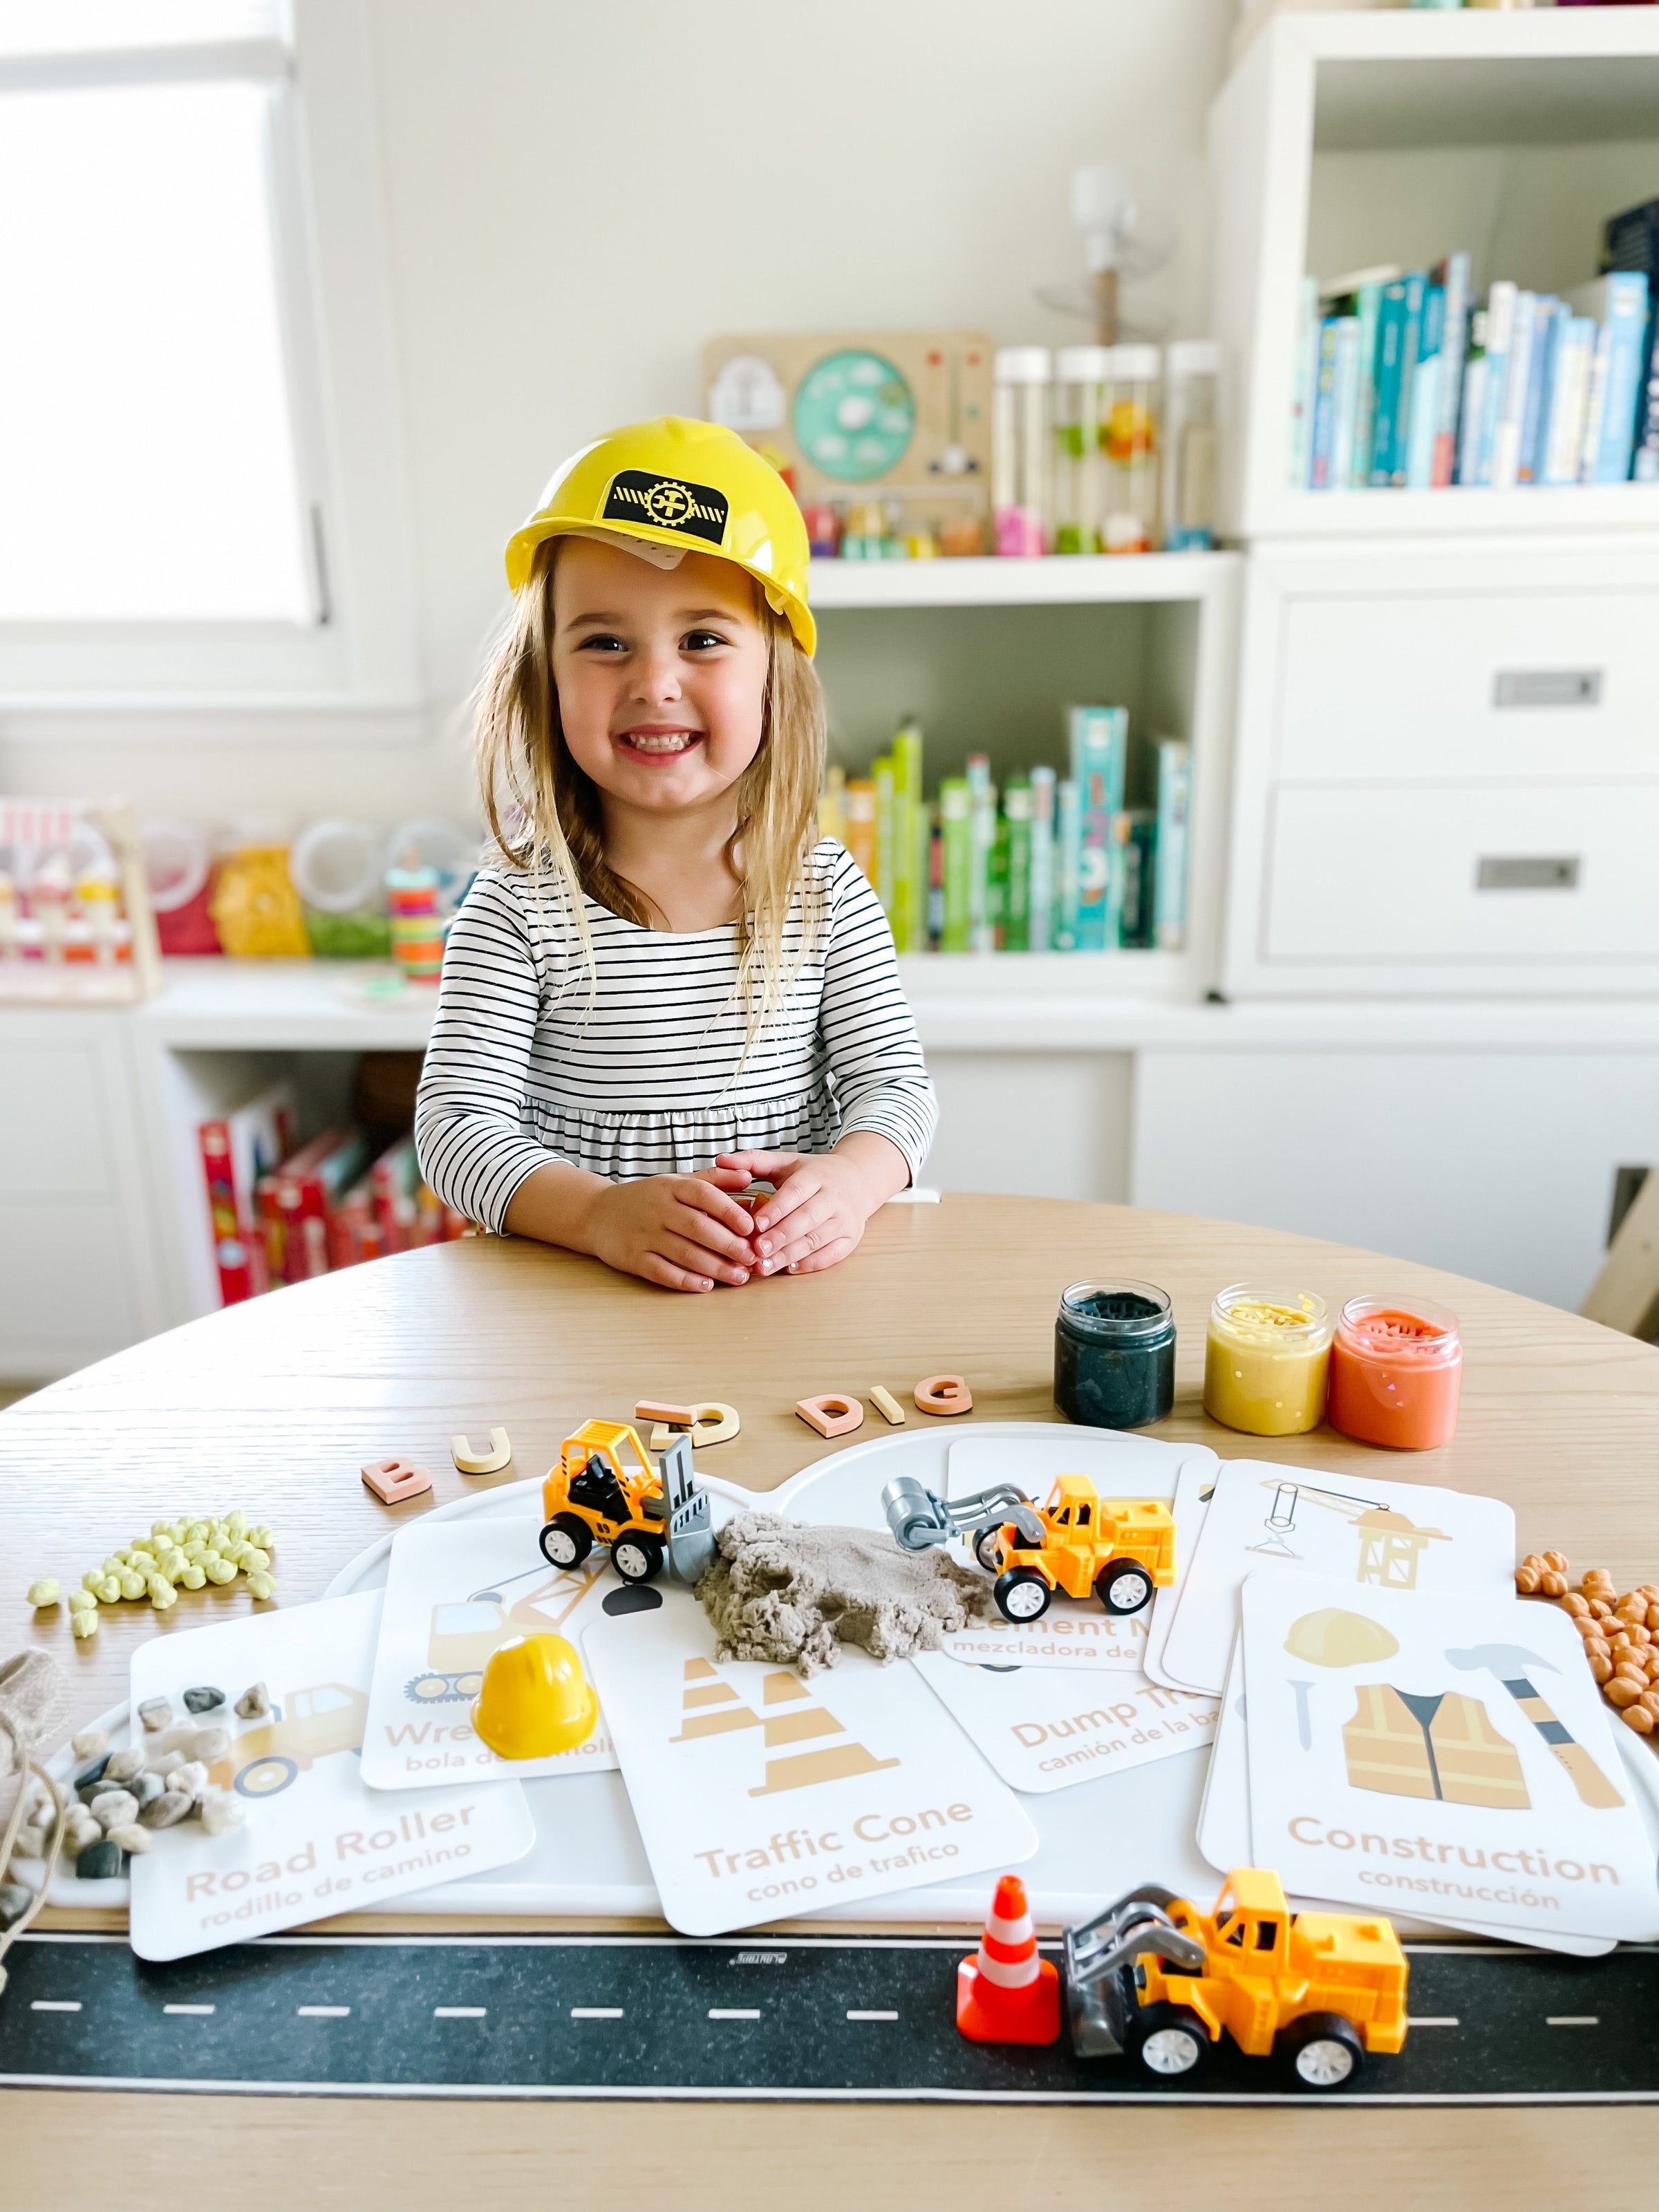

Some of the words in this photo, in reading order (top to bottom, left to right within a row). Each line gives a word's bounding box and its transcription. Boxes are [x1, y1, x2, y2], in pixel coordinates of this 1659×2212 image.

[796, 1374, 973, 1438] DIG
[596, 1523, 610, 1534] 89
[953, 1640, 1097, 1657] mezcladora
[1106, 1645, 1137, 1658] de
[384, 1721, 474, 1747] Wre
[1010, 1703, 1138, 1748] Dump
[1038, 1739, 1127, 1772] camión
[1131, 1728, 1163, 1744] de
[1161, 1720, 1190, 1734] la
[406, 1752, 465, 1771] bola
[185, 1842, 316, 1902] Road
[333, 1805, 475, 1861] Roller
[694, 1828, 843, 1878] Traffic
[853, 1803, 973, 1841] Cone
[1287, 1816, 1620, 1885] Construction
[200, 1887, 302, 1930] rodillo
[314, 1877, 353, 1897] de
[362, 1841, 472, 1884] camino
[747, 1877, 818, 1902] cono
[827, 1864, 863, 1883] de
[870, 1844, 959, 1873] trafico
[1358, 1869, 1560, 1910] construcción
